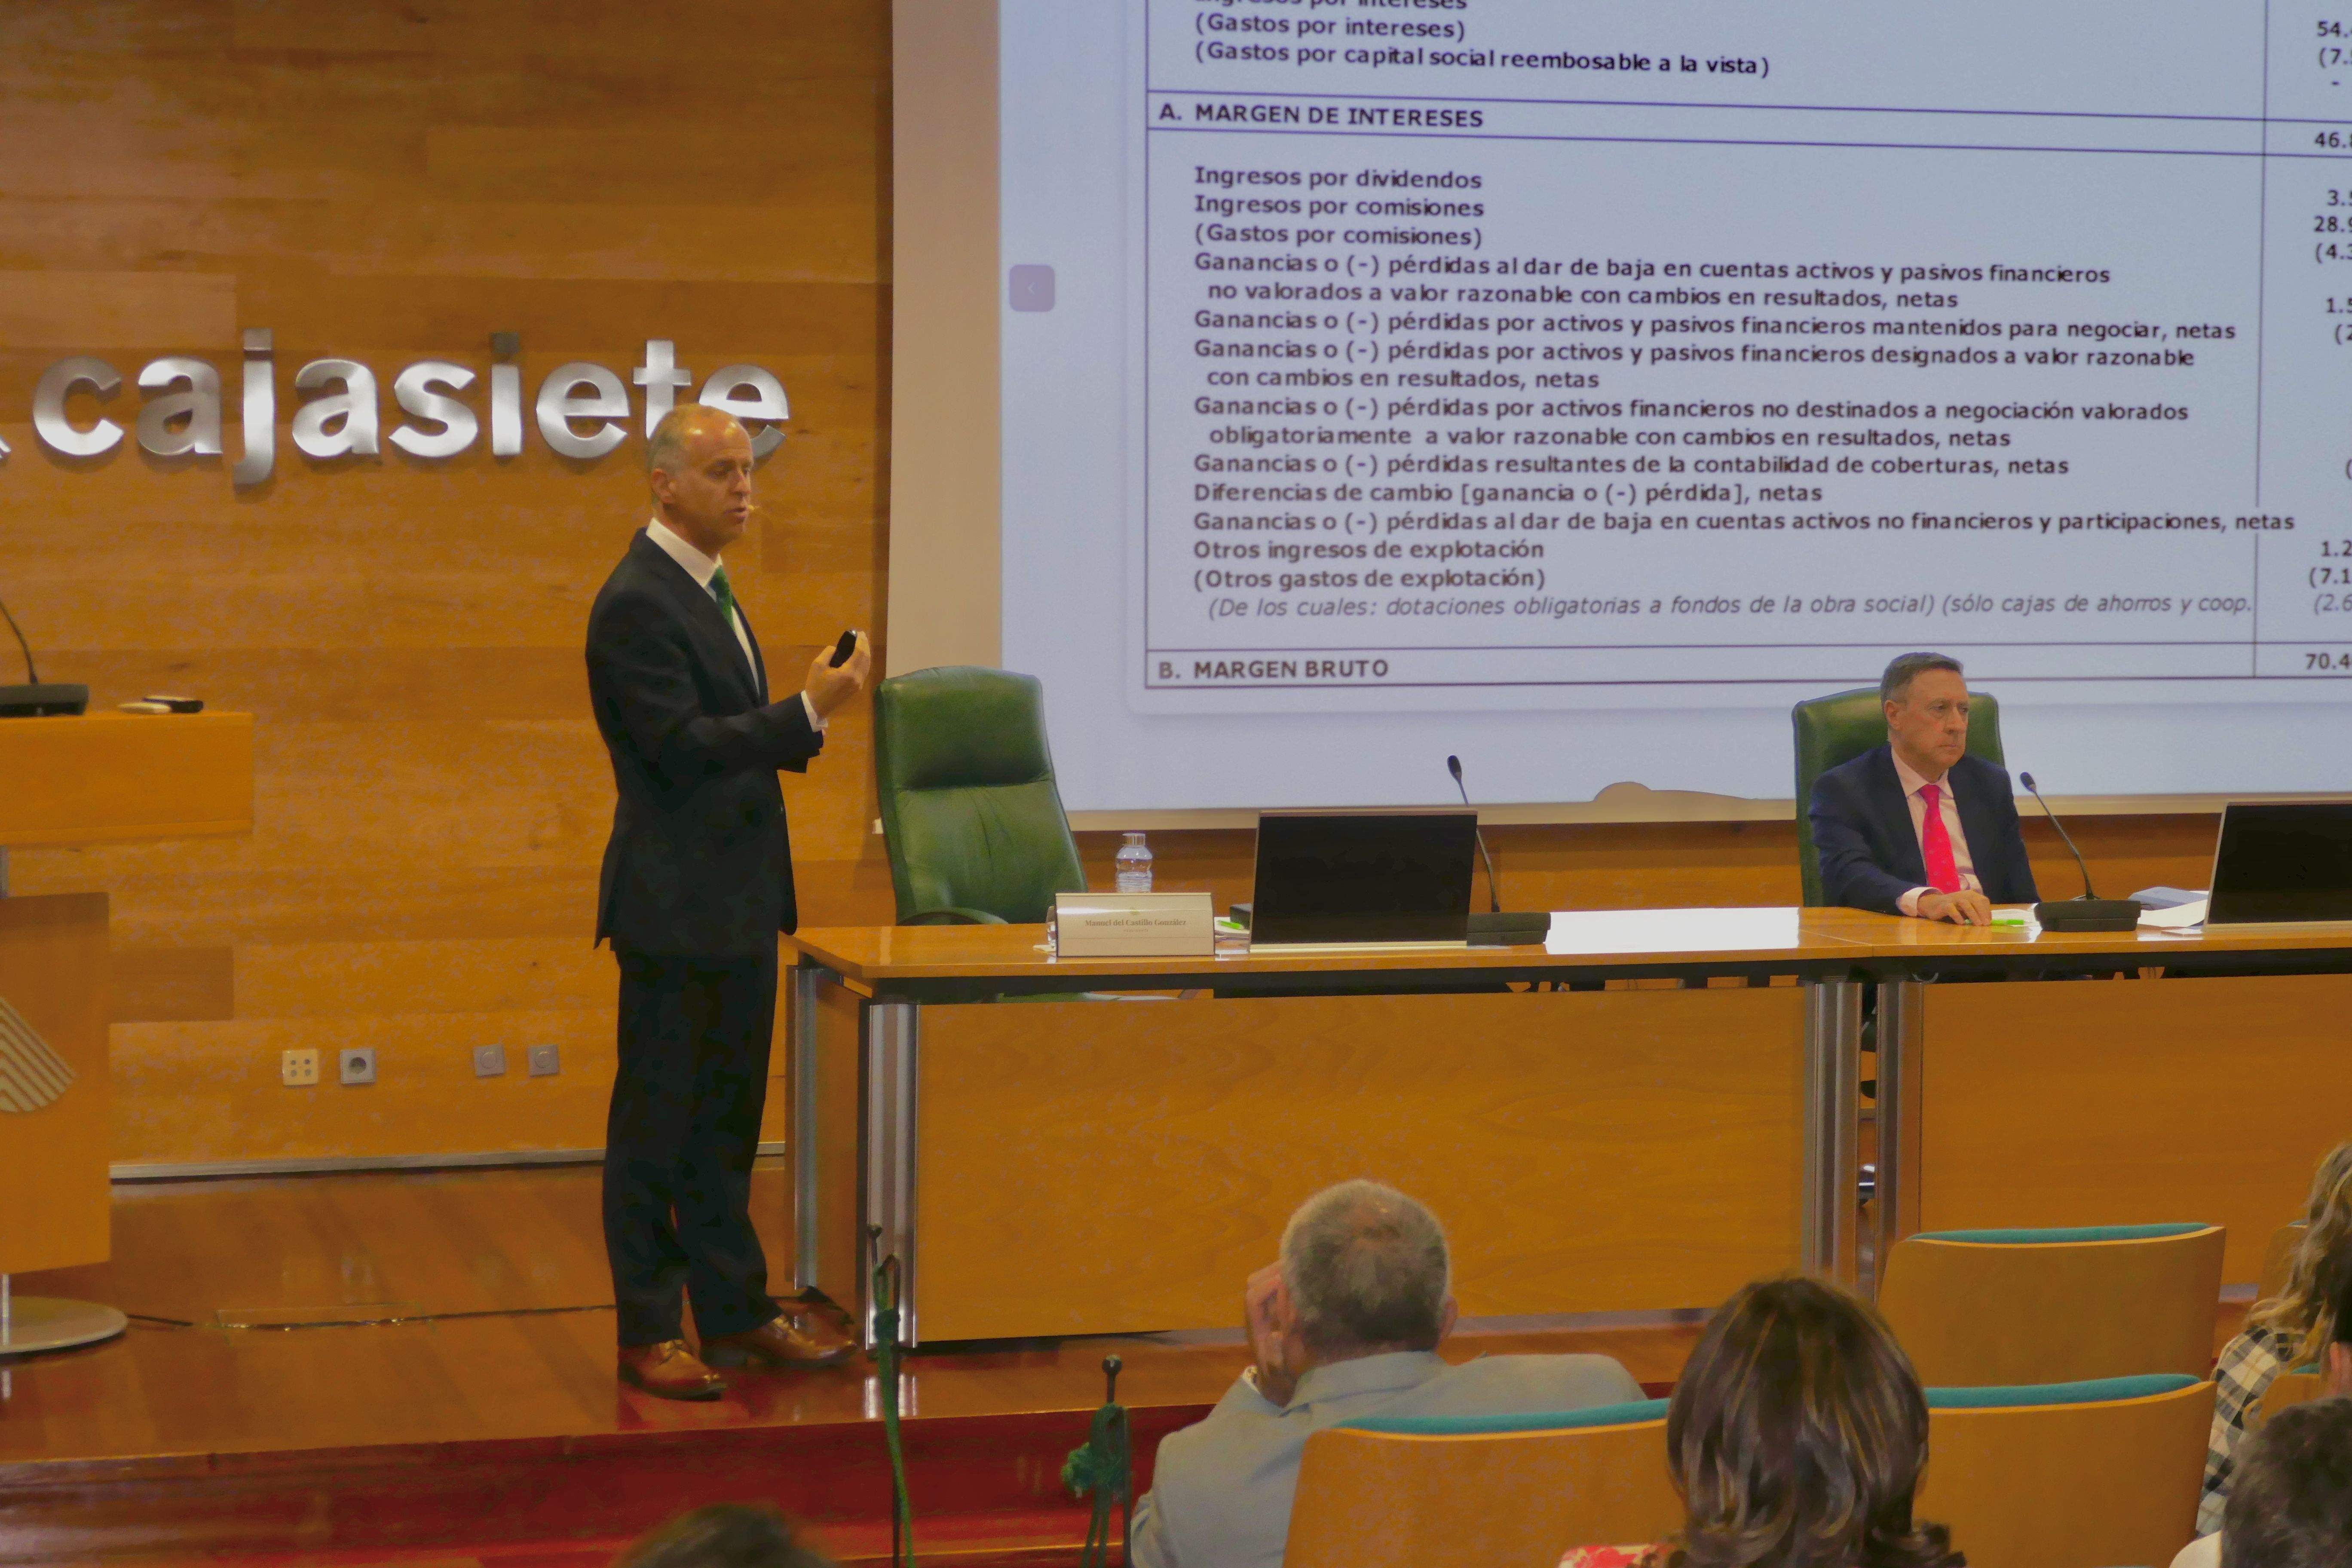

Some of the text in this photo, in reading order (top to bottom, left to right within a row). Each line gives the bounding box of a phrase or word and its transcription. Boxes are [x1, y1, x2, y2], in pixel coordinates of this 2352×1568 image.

[1195, 12, 1466, 44] (Gastos por intereses)
[1195, 40, 1770, 80] (Gastos por capital social reembosable la vista)
[1158, 102, 1484, 129] A. MARGEN DE INTERESES
[1194, 165, 1483, 191] Ingresos por dividendos
[1194, 194, 1485, 220] Ingresos por comisiones
[1195, 222, 1482, 251] (Gastos por comisiones)
[1194, 251, 2111, 285] Ganancias pérdidas al dar de baja en cuentas activos pasivos financieros
[1207, 281, 1959, 311] no valorados valor razonable con cambios en resultados, netas
[1194, 309, 2236, 343] Ganancias pérdidas por activos pasivos financieros mantenidos para negociar, netas
[1194, 338, 2195, 369] Ganancias pérdidas por activos pasivos financieros designados valor razonable
[1206, 368, 1600, 392] con cambios en resultados, netas
[33, 327, 790, 486] cajasiete
[1194, 395, 2189, 424] Ganancias pérdidas por activos financieros no destinados negociación valorados
[1209, 425, 2012, 450] obligatoriamente valor razonable con cambios en resultados, netas
[1193, 453, 2070, 478] Ganancias pérdidas resultantes de la contabilidad de coberturas, netas
[1194, 481, 1823, 507] Diferencias de cambio [ganancia pérdida], netas
[1193, 510, 2296, 535] Ganancias pérdidas al dar de baja en cuentas activos no financieros participaciones, netas
[1193, 538, 1544, 564] Otros ingresos de explotación
[1194, 567, 1546, 593] (Otros gastos de explotación)
[1209, 593, 2252, 621] (De los cuales: dotaciones obligatorias fondos de la obra social) (sólo cajas de ahorros coop.
[1158, 658, 1389, 680] B. MARGEN BRUTO
